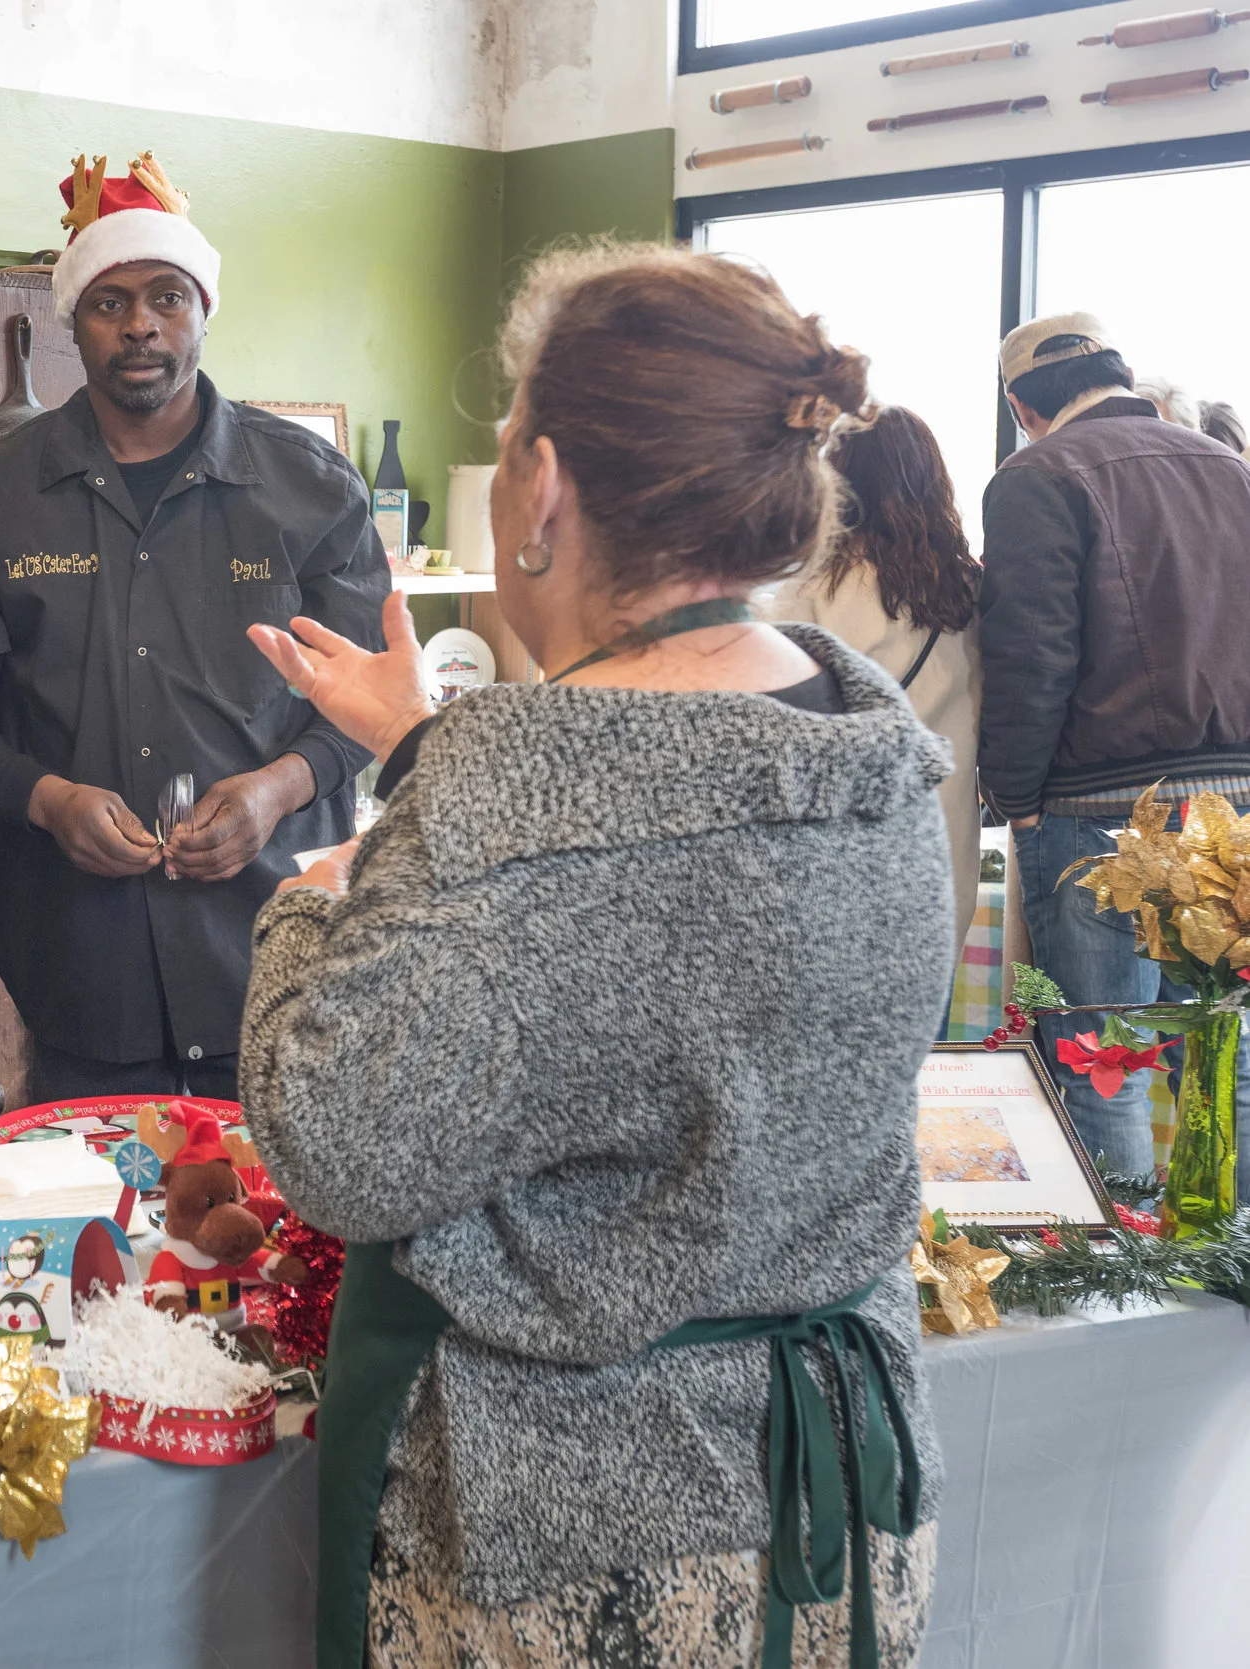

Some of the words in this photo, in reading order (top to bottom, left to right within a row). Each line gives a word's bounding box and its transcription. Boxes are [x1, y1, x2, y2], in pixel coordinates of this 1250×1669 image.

[5, 558, 25, 579] Let
[42, 554, 71, 575] Cater
[71, 553, 92, 575] For
[230, 557, 271, 582] Paul
[939, 1063, 974, 1072] Item!!
[922, 1085, 949, 1095] With
[953, 1085, 994, 1095] Tortilla
[997, 1085, 1030, 1096] Chips
